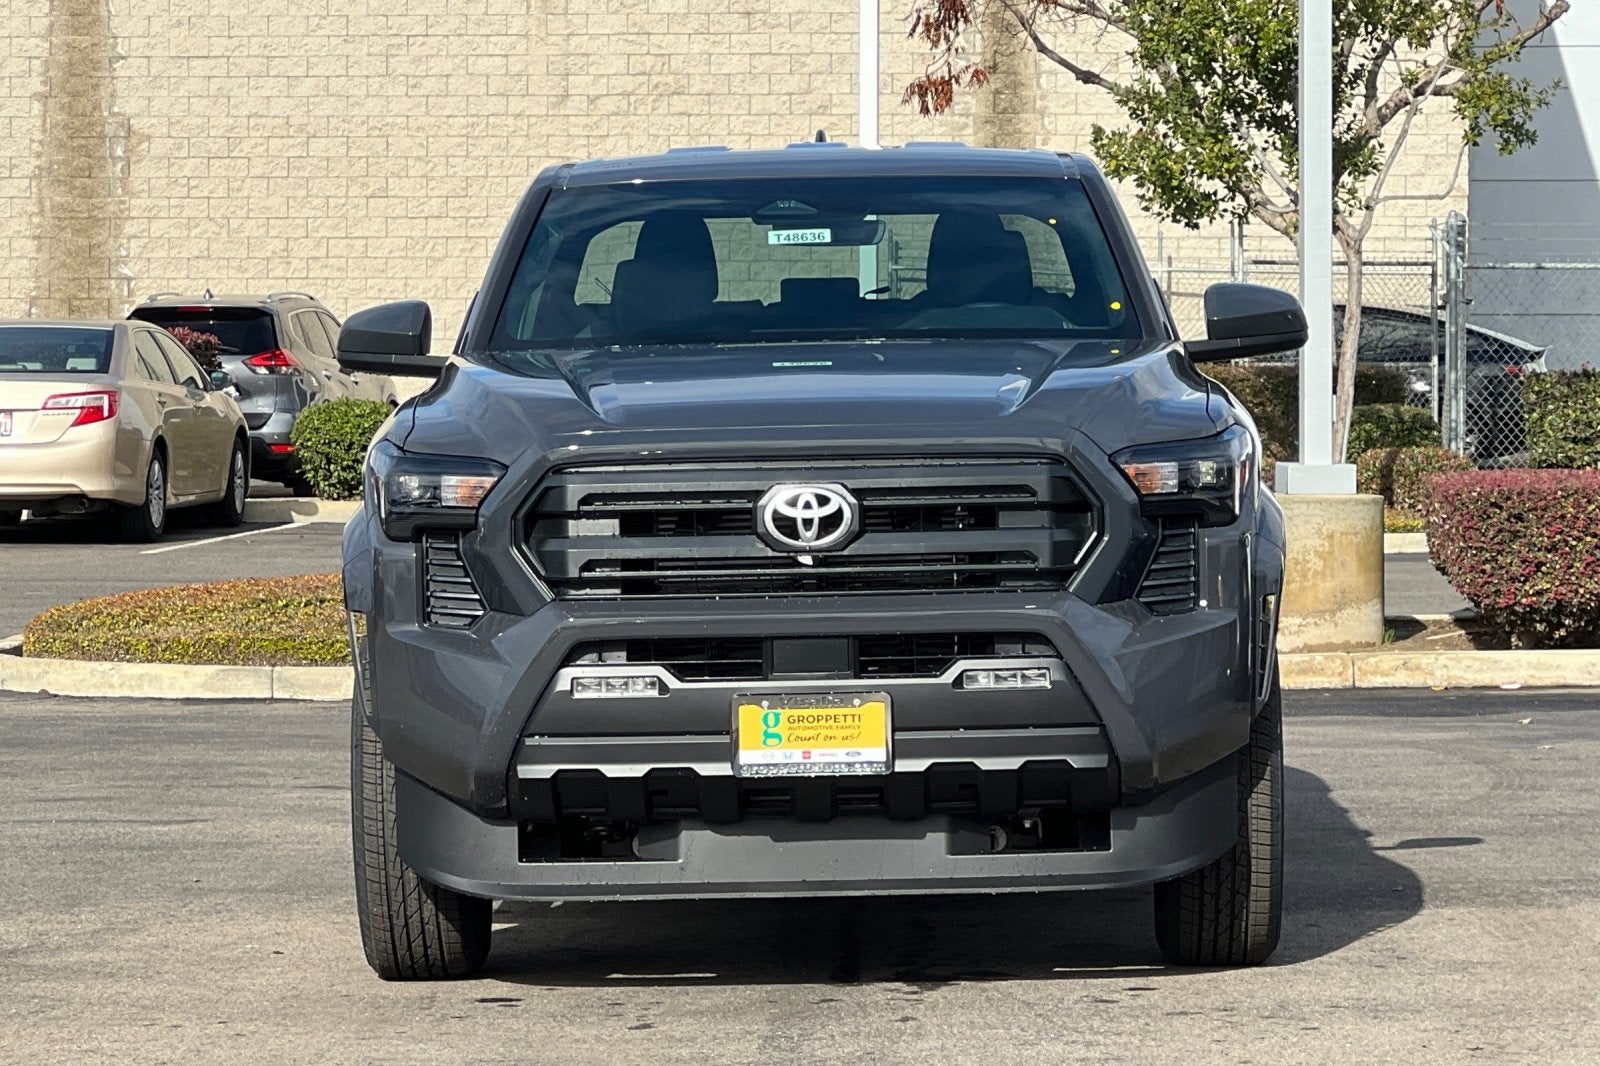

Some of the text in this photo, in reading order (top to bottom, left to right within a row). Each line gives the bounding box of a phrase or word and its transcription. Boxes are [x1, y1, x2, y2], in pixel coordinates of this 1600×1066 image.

[774, 232, 826, 243] T48636
[787, 714, 862, 724] GROPPETTI
[787, 732, 821, 743] Count
[841, 731, 861, 741] us!
